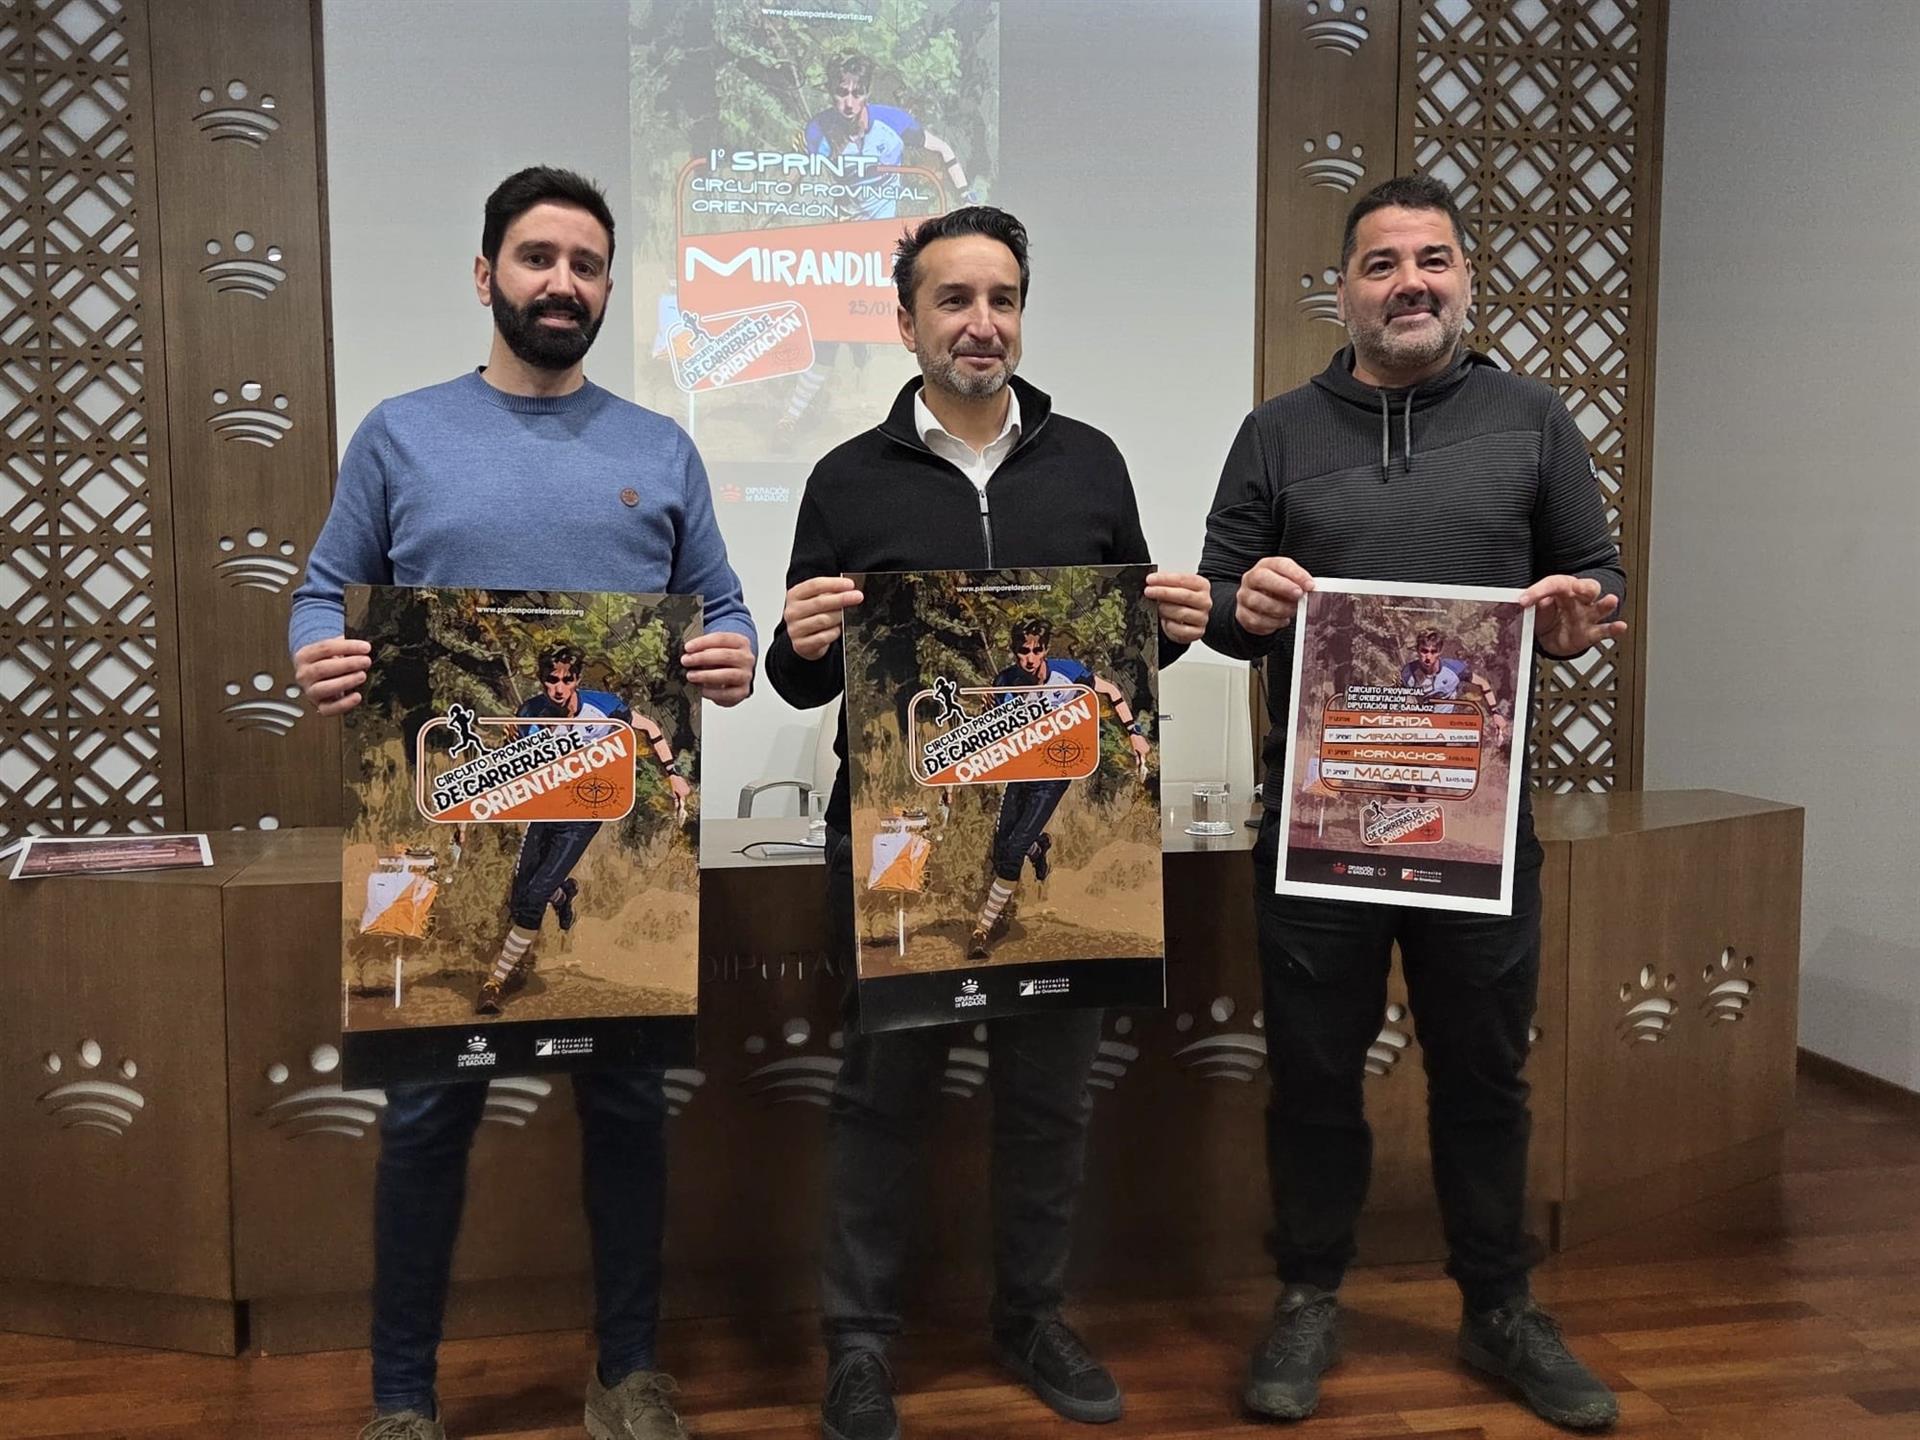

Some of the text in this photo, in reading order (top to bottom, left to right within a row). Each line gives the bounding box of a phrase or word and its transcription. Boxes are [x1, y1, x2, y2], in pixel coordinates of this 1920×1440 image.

[732, 151, 878, 177] SPRINT
[691, 178, 929, 200] CIRCUITO PROVINCIAL
[692, 200, 838, 217] ORIENTACIÓN
[685, 314, 773, 384] DE CARRERAS DE
[1348, 686, 1424, 696] CIRCUITO PROVINCIAL
[1360, 712, 1433, 727] MÉRIDA
[1401, 704, 1434, 712] BADAJOZ
[924, 698, 1052, 775] DE CARRERAS DE
[926, 697, 1026, 754] CIRCUITO PROVINCIAL
[955, 700, 1092, 782] ORIENTACIÓN
[436, 729, 553, 787] CIRCUITO PROVINCIAL
[1354, 749, 1446, 761] HORNACHOS
[434, 731, 584, 811] DE CARRERAS DE
[470, 735, 628, 820] ORIENTACIÓN
[1354, 767, 1441, 782] MAGACELA
